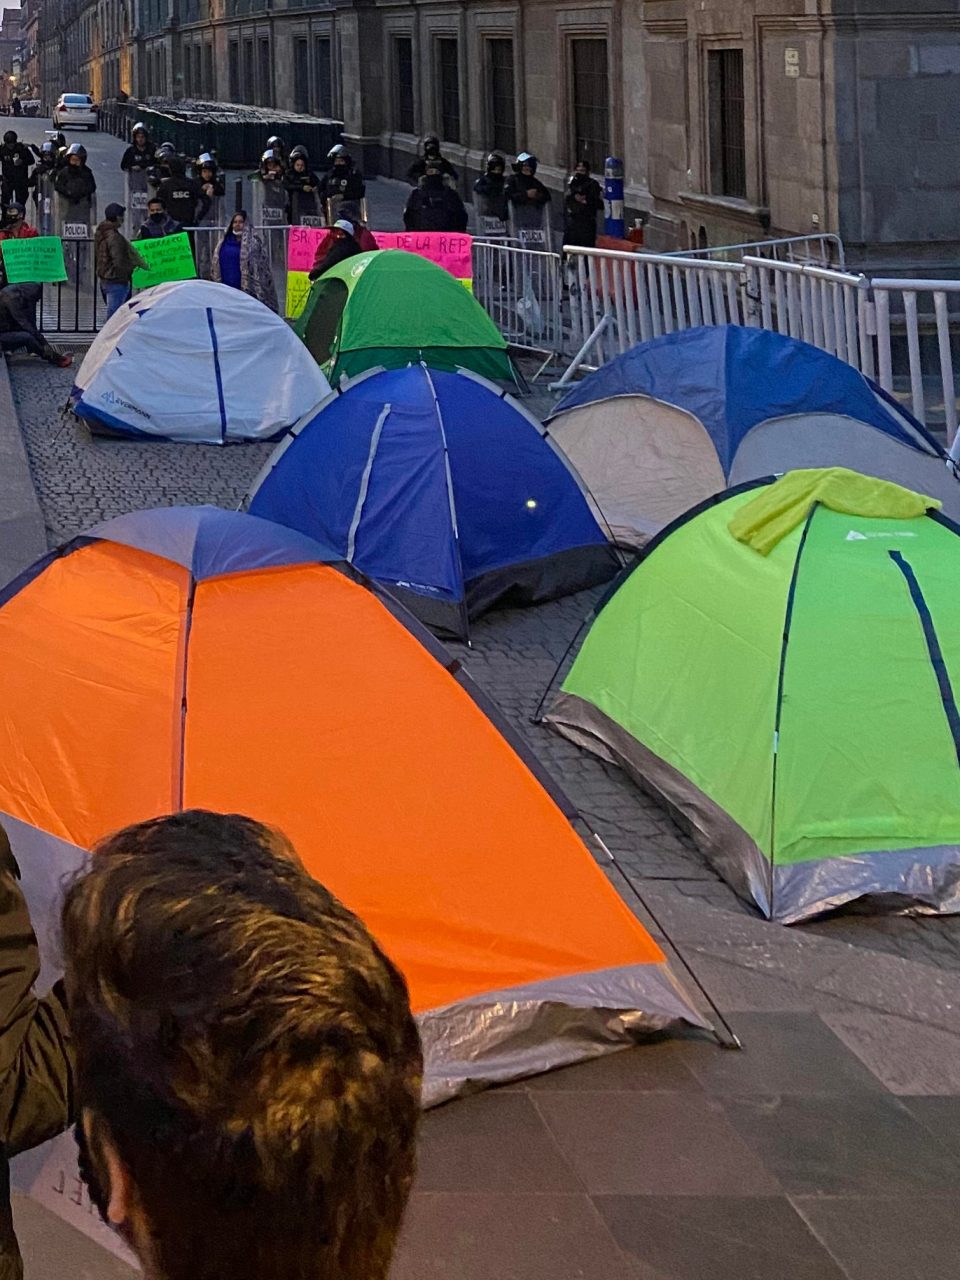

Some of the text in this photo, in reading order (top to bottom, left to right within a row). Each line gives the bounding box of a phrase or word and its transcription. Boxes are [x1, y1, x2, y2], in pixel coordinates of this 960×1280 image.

[65, 226, 85, 235] POLICIA
[293, 230, 310, 243] SR.
[397, 235, 411, 248] DE
[416, 236, 430, 250] LA
[440, 236, 468, 254] REP.
